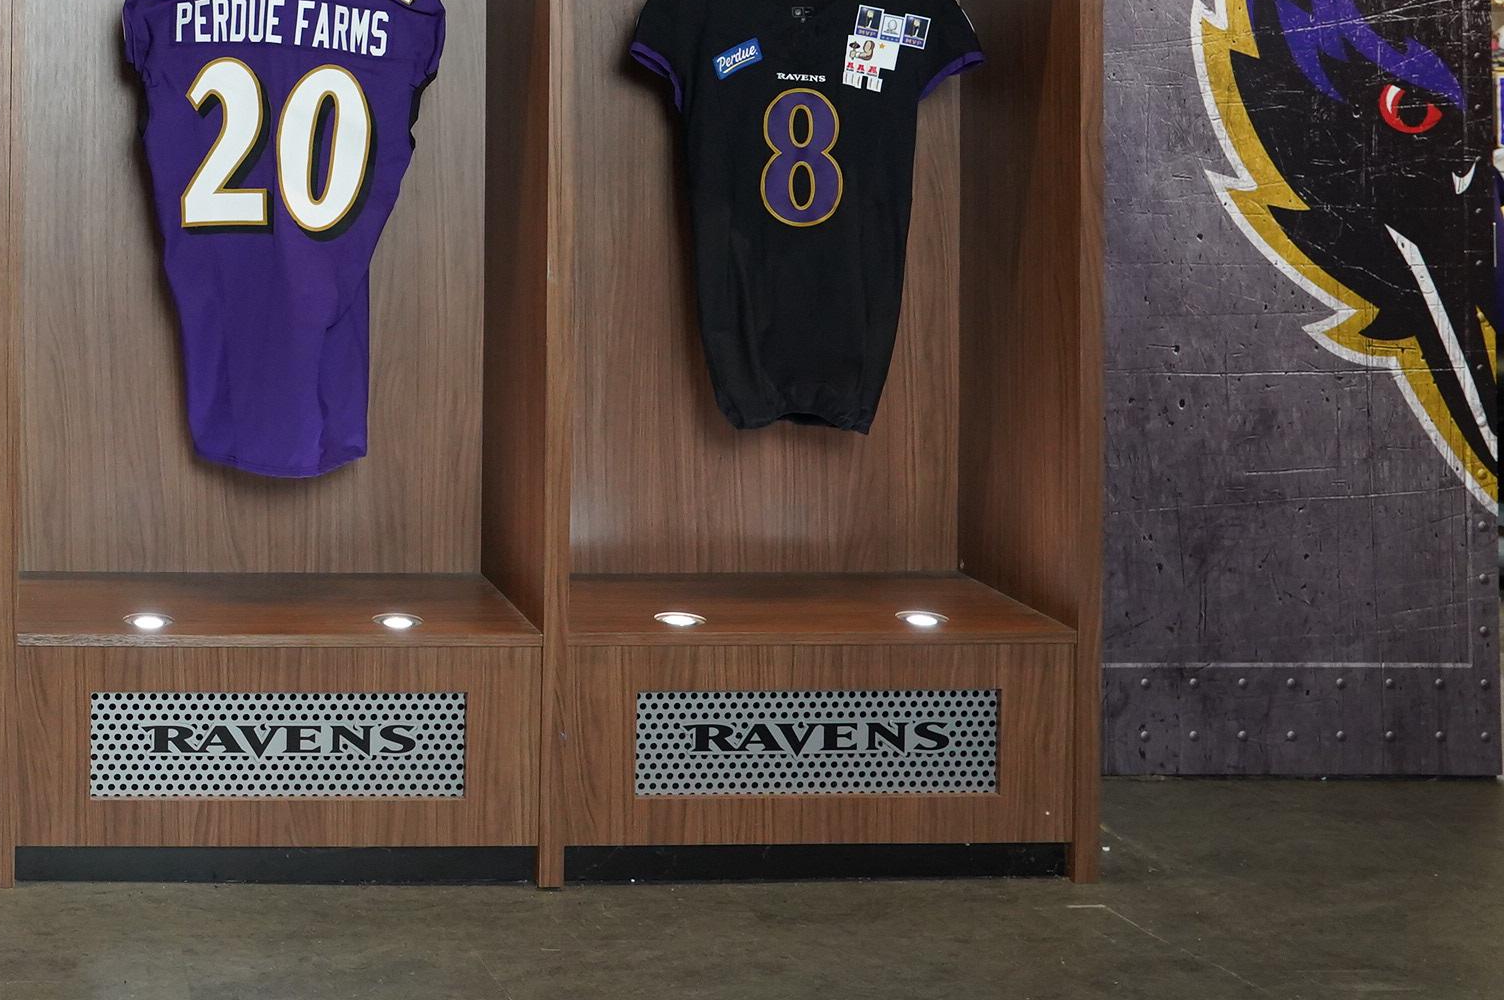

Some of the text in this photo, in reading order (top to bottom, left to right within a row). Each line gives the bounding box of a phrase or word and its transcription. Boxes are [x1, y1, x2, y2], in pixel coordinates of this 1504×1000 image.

[294, 0, 390, 57] FARMS
[857, 28, 877, 37] MVP
[905, 37, 923, 46] MVP
[717, 45, 758, 72] Perdue
[776, 72, 826, 83] RAVENS
[181, 56, 373, 233] 20
[760, 87, 844, 228] 8
[141, 724, 417, 760] RAVENS
[683, 722, 949, 757] RAVENS
